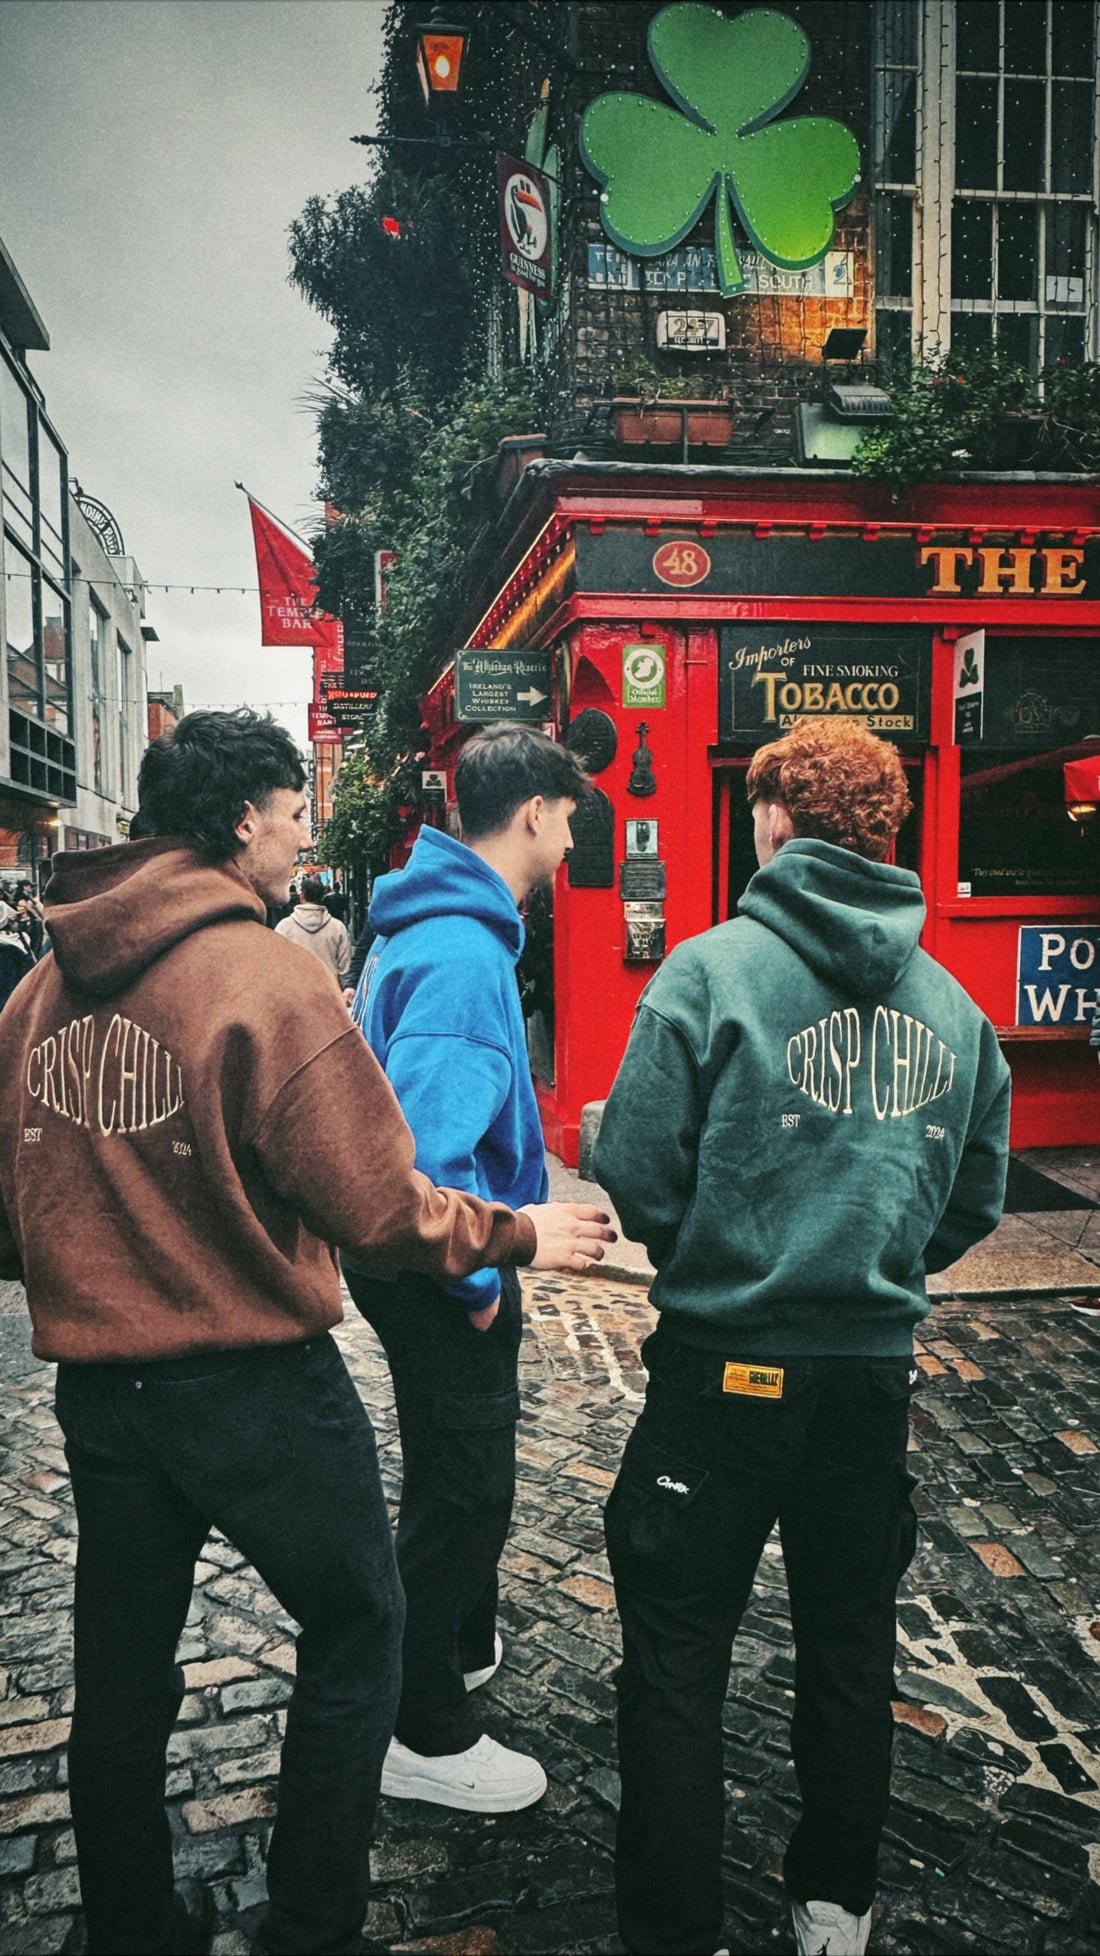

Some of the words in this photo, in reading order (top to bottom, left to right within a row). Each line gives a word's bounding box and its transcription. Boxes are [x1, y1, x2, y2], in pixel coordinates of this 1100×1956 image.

[510, 252, 546, 280] GUINNESS
[758, 274, 813, 290] SOUTH
[663, 549, 698, 576] 48
[921, 547, 1087, 595] THE
[283, 597, 308, 606] THE
[267, 606, 325, 620] TEMPLE
[282, 618, 314, 629] BAR
[728, 637, 811, 671] Importers
[473, 658, 513, 676] Whiskey
[780, 657, 796, 667] OF
[803, 665, 834, 677] FINE
[836, 665, 899, 677] SMOKING
[631, 687, 658, 696] Official
[631, 694, 660, 703] Member
[751, 672, 899, 723] TOBACCO
[866, 716, 912, 728] Stock
[1038, 933, 1100, 970] PO
[787, 1007, 861, 1115] CRISP
[27, 1014, 95, 1128] CRISP
[782, 1114, 800, 1128] EST
[24, 1128, 43, 1142] EST
[925, 1125, 945, 1139] 2024
